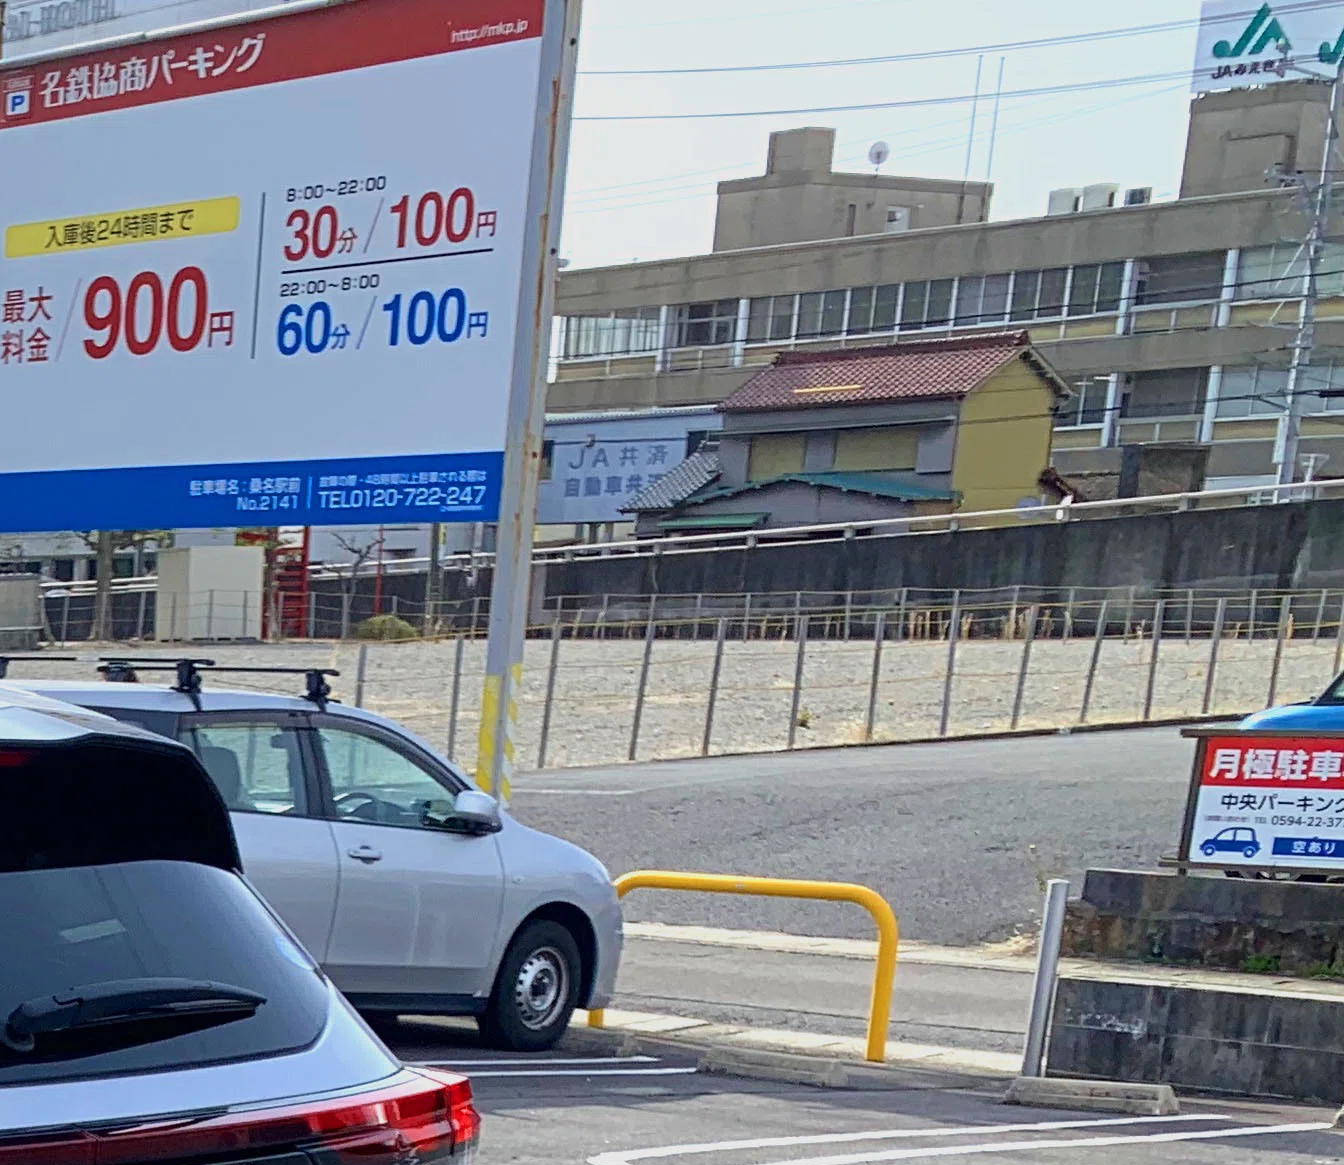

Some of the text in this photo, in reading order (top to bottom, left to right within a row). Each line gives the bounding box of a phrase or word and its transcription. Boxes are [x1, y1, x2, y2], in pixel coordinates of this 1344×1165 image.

[40, 33, 266, 108] 名鉄協商パーキング
[44, 209, 195, 249] 入庫後24時間まで
[2, 286, 54, 324] 最大
[0, 327, 52, 364] 料金
[1209, 748, 1344, 781] 月極駐車
[1271, 815, 1344, 828] 0594-22-37
[1291, 840, 1336, 855] 空あり
